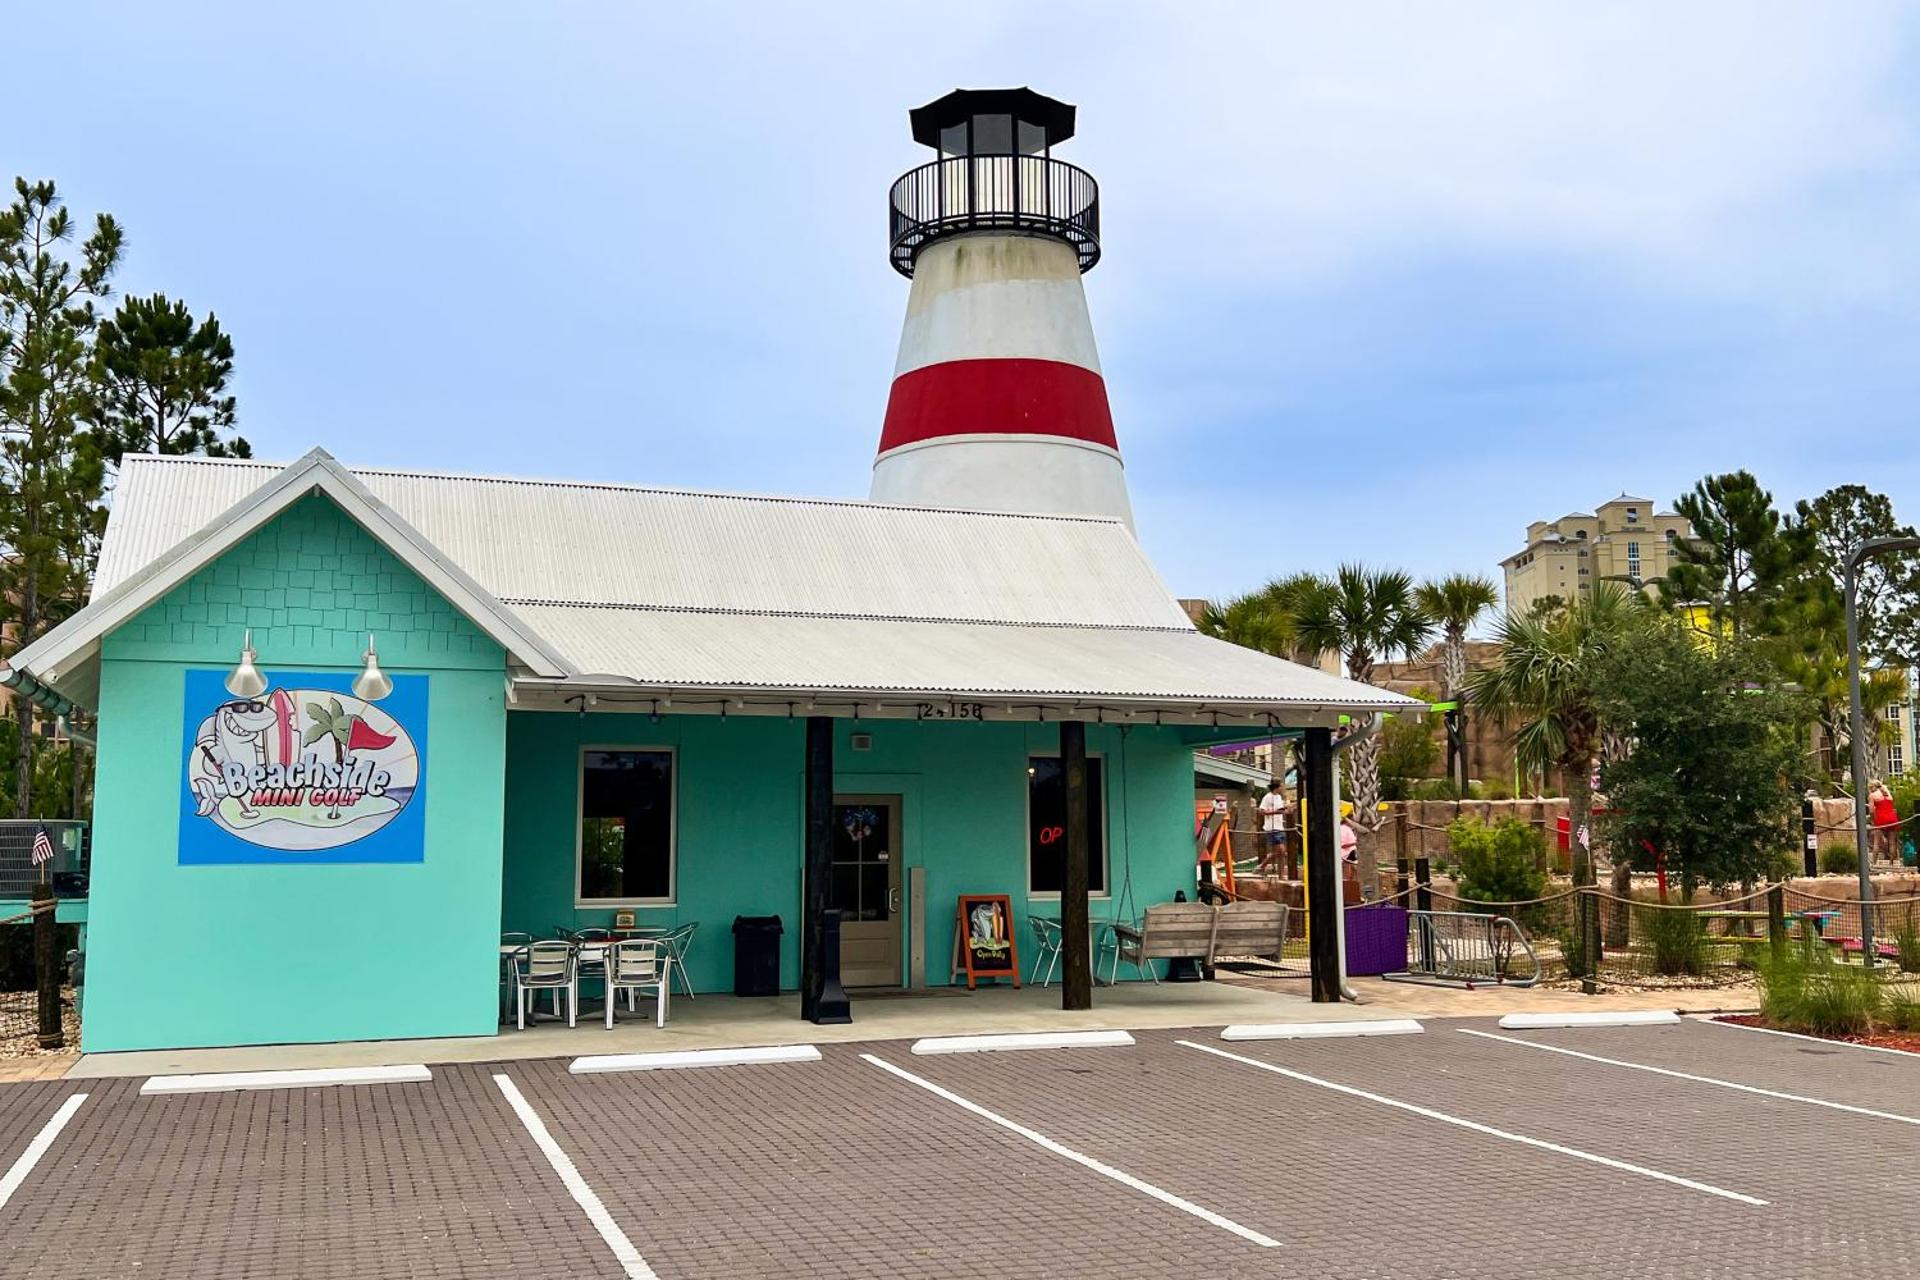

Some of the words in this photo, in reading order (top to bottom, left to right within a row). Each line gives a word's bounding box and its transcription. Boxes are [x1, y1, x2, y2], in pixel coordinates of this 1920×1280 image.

[223, 753, 391, 797] Beachside
[251, 787, 304, 807] MINI
[309, 787, 363, 807] GOLF
[1040, 827, 1063, 844] OP
